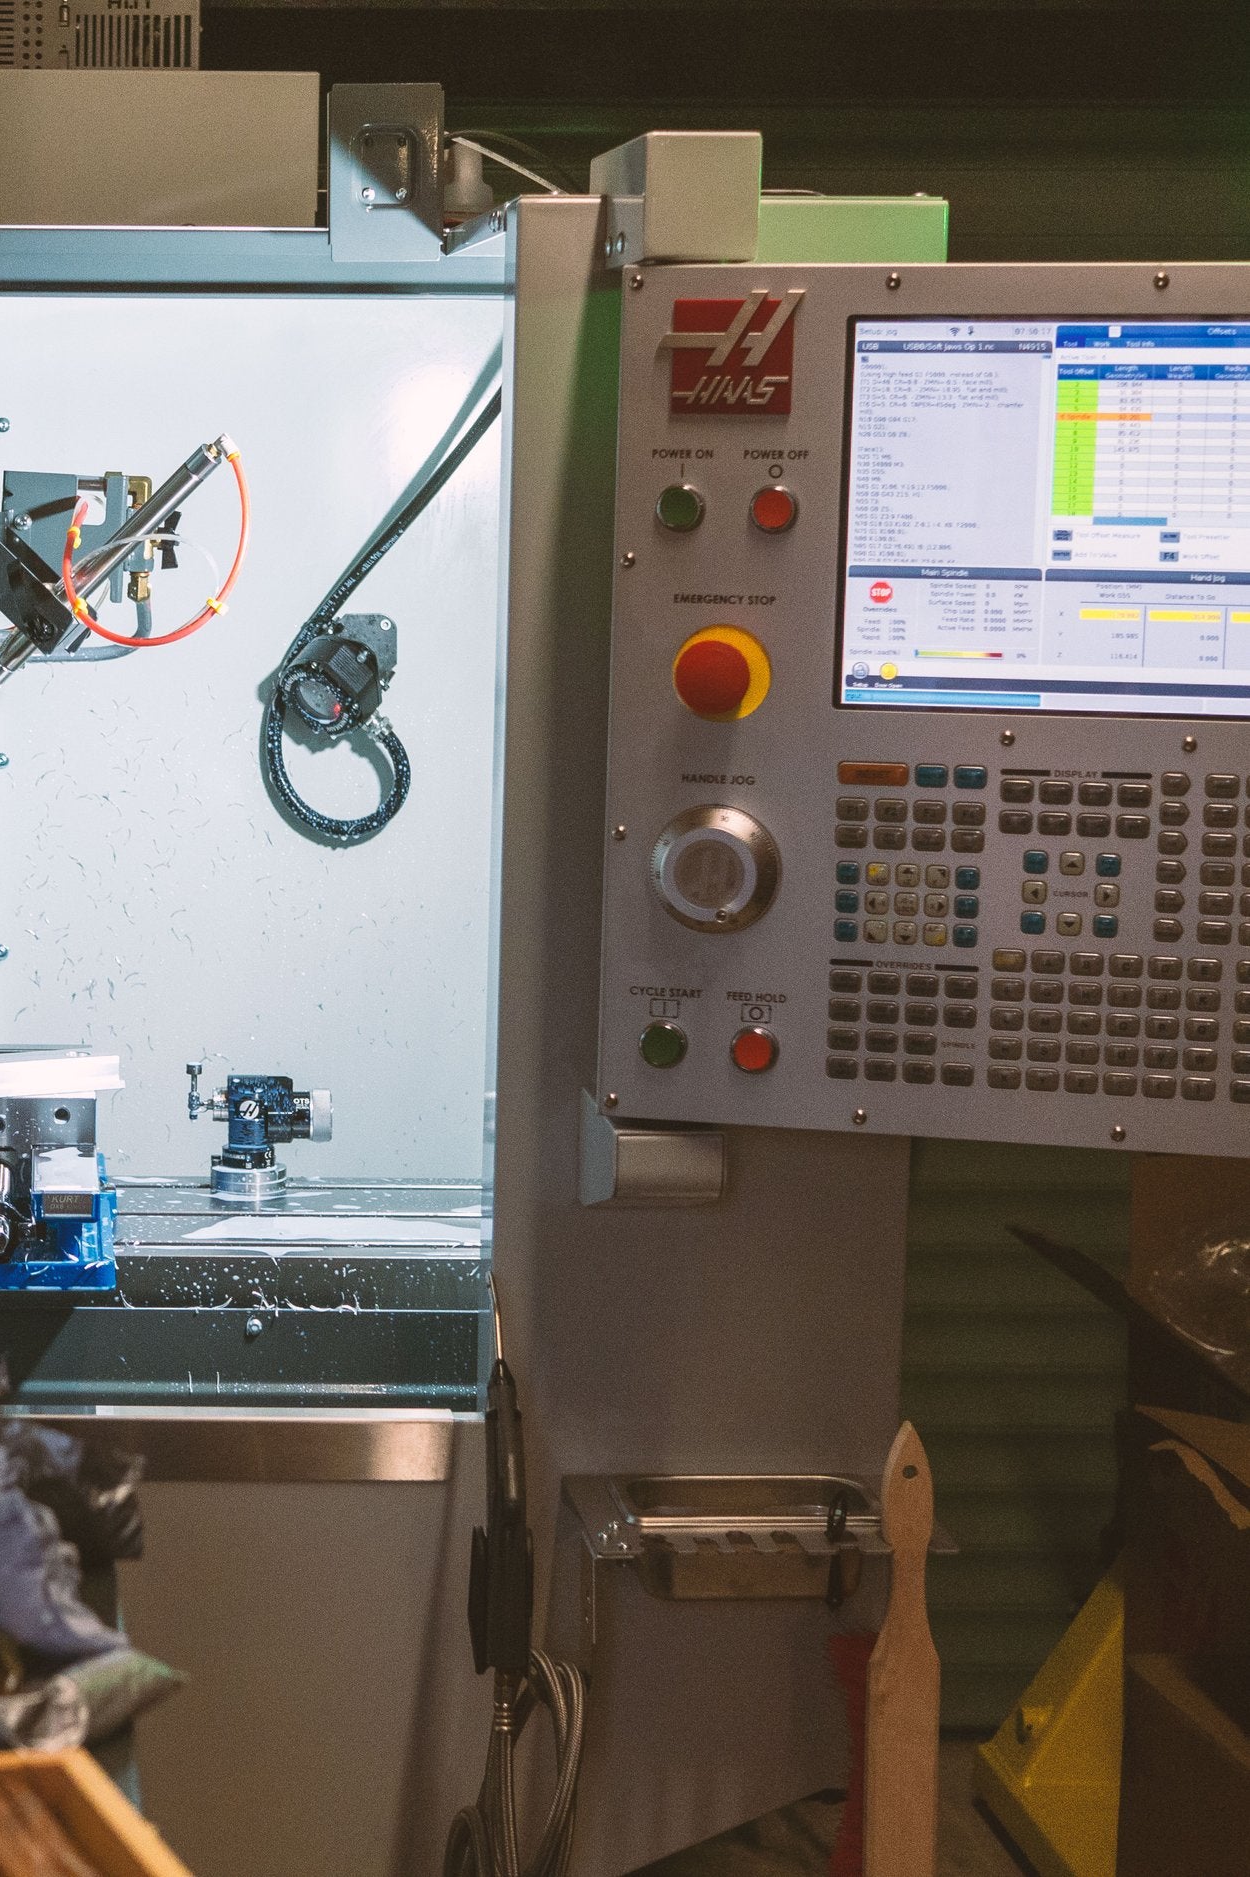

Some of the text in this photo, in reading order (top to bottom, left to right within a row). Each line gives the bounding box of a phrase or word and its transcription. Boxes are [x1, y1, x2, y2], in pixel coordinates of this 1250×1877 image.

[861, 343, 879, 351] USB
[964, 343, 975, 352] Op
[1114, 365, 1138, 373] Length
[1169, 365, 1193, 373] Length
[672, 376, 790, 405] HAAS
[652, 449, 714, 459] POWER ON
[743, 450, 809, 460] POWER OFF
[1112, 532, 1141, 540] Measure
[1163, 551, 1175, 560] F4
[921, 568, 969, 578] Main Spindle
[1190, 573, 1212, 582] Hand
[930, 582, 954, 590] Spindle
[871, 588, 891, 597] STOP
[930, 591, 954, 599] Spindle
[673, 594, 776, 606] EMERGENCY STOP
[928, 599, 954, 607] Surface
[943, 608, 959, 616] Chip
[1054, 770, 1098, 779] DISPLAY
[681, 773, 755, 786] HANDLE JOG
[1053, 889, 1089, 898] CURSOR
[876, 961, 932, 971] OVERRIDES
[629, 985, 703, 999] CYCLE START
[726, 991, 787, 1003] FEED HOLD
[51, 1195, 79, 1204] KURT
